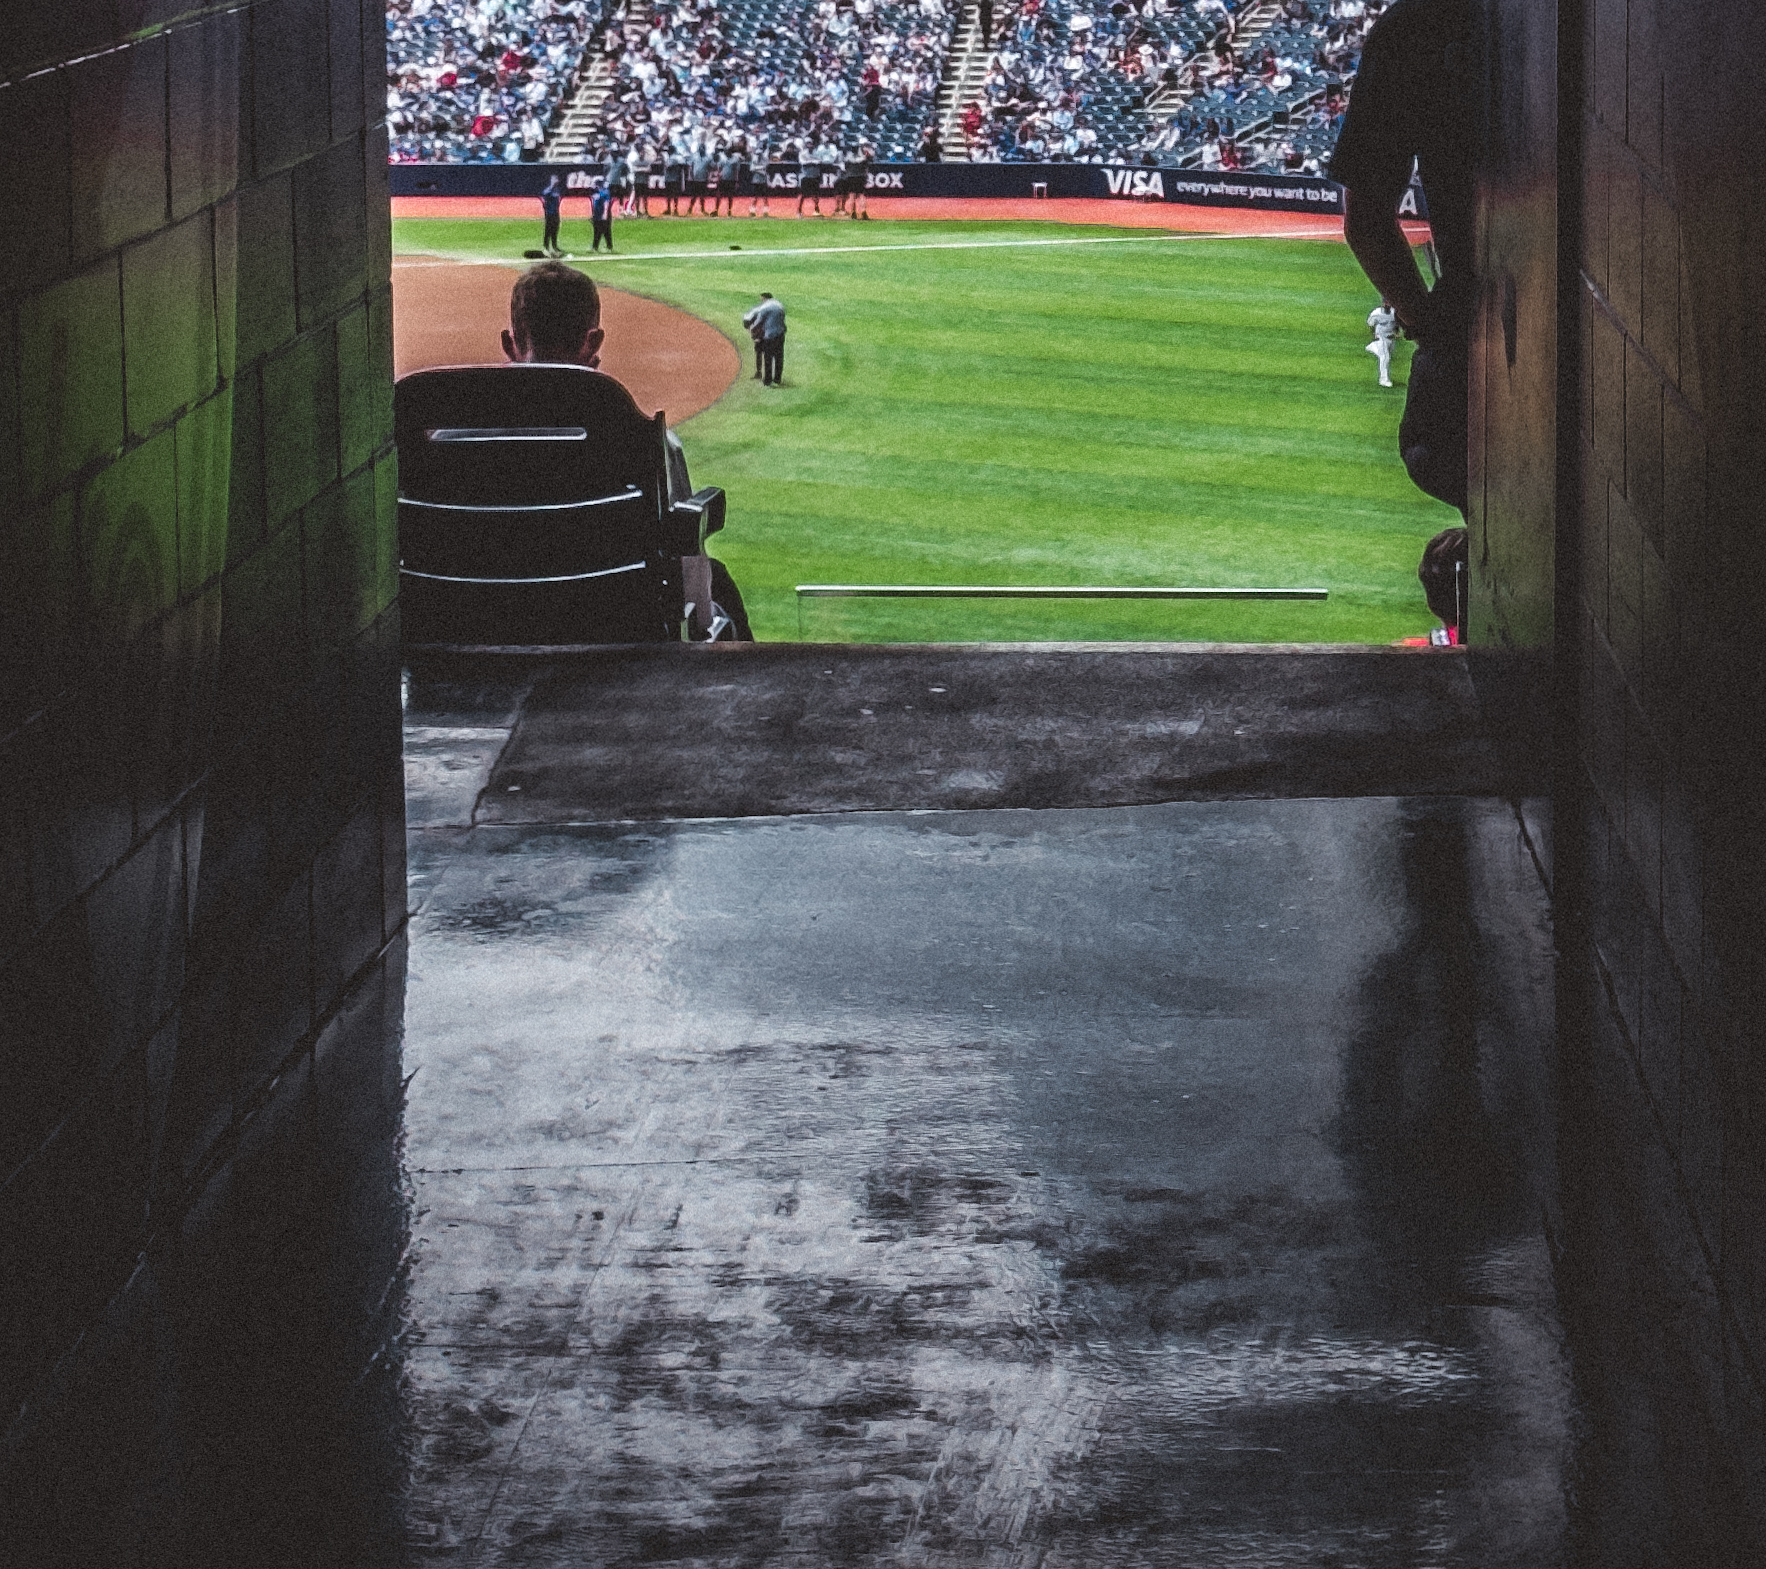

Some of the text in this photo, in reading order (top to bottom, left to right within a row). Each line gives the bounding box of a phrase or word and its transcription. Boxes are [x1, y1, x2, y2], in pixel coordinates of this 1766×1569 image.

[1103, 169, 1164, 197] VISA
[1176, 180, 1338, 203] everywhere you want to be
